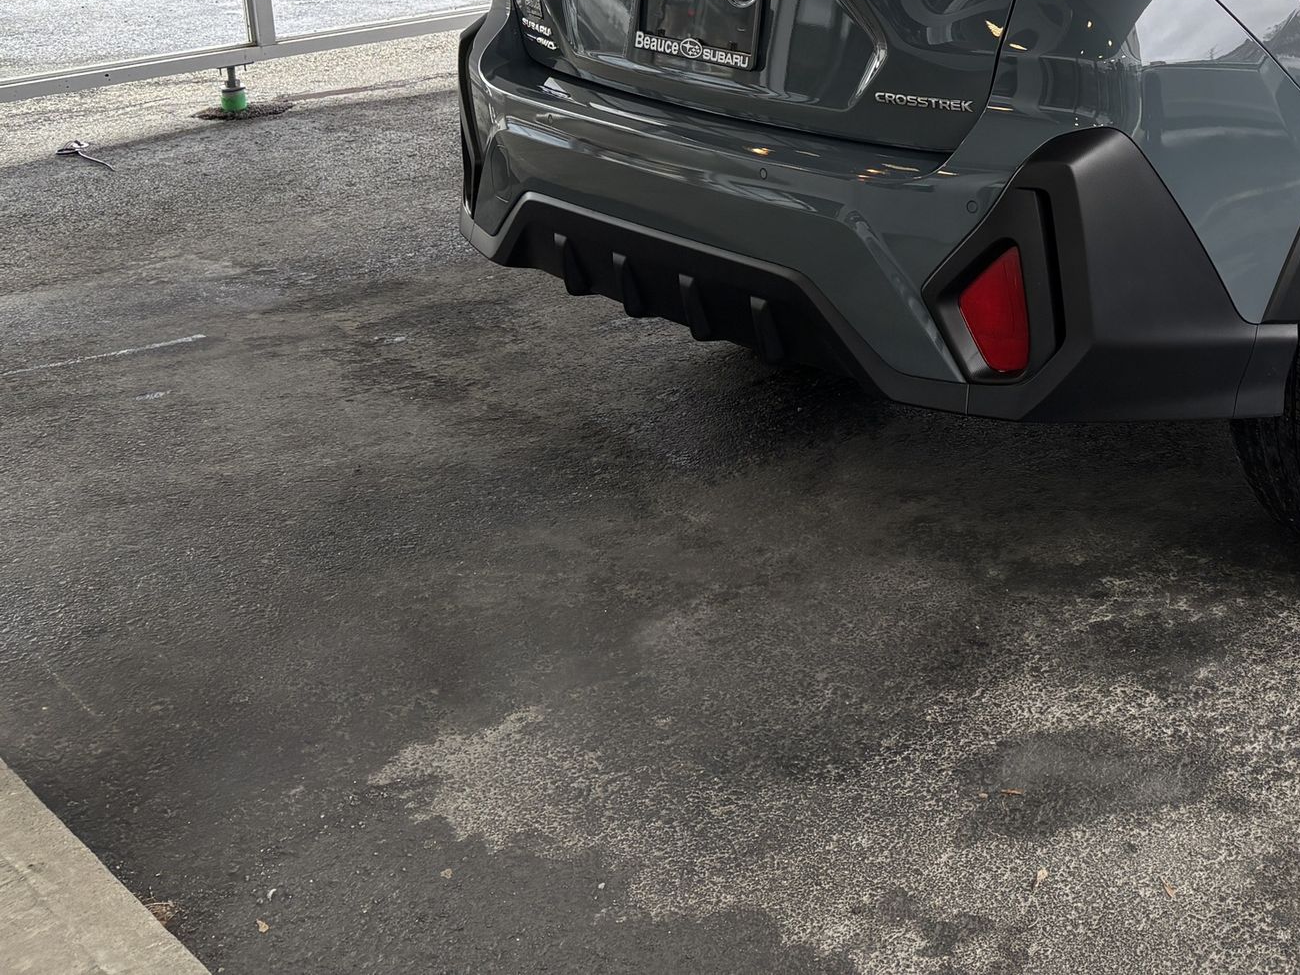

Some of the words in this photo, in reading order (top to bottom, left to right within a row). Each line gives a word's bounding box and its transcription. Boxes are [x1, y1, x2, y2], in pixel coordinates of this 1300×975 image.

[635, 31, 679, 55] Beauce
[702, 48, 749, 68] SUBARU
[874, 92, 974, 113] CROSSTREK
